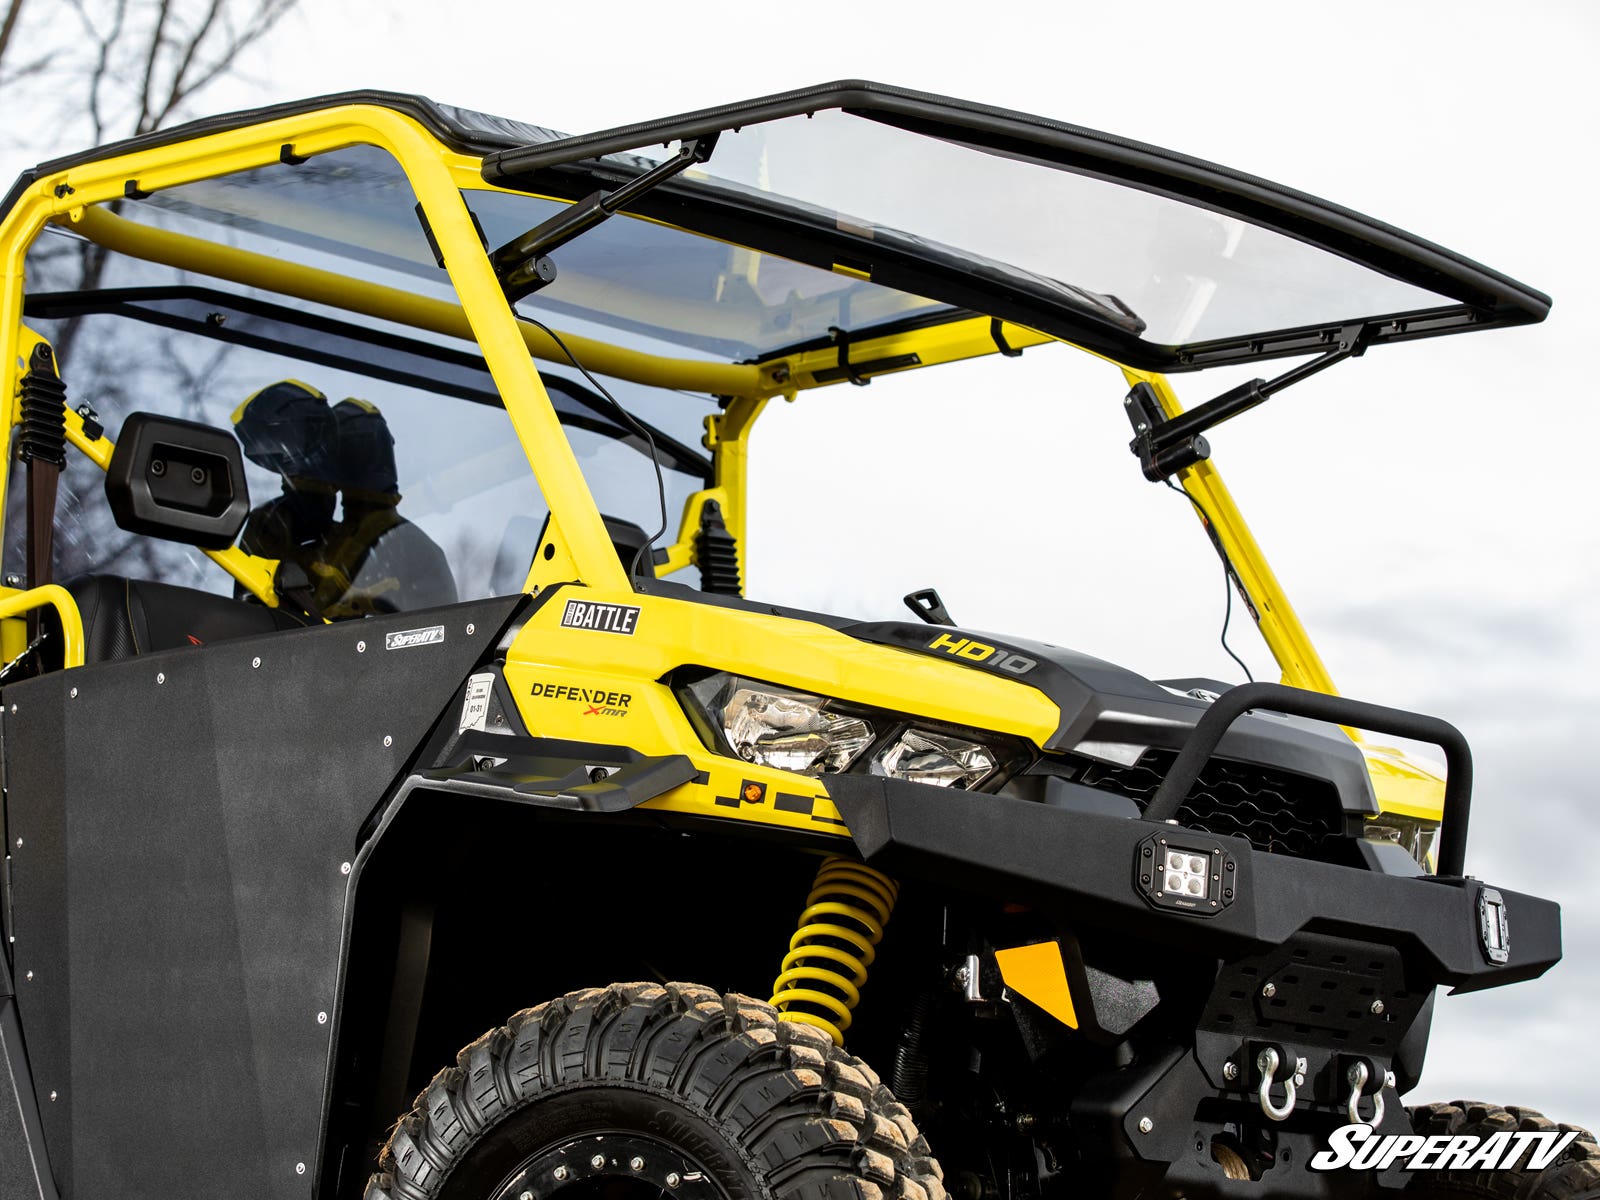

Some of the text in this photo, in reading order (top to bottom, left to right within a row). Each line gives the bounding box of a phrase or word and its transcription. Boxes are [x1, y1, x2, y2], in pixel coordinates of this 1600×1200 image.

[572, 603, 636, 633] BATTLE
[391, 629, 440, 647] SUPERATV
[928, 633, 1038, 674] HD10
[530, 683, 632, 708] DEFENDER
